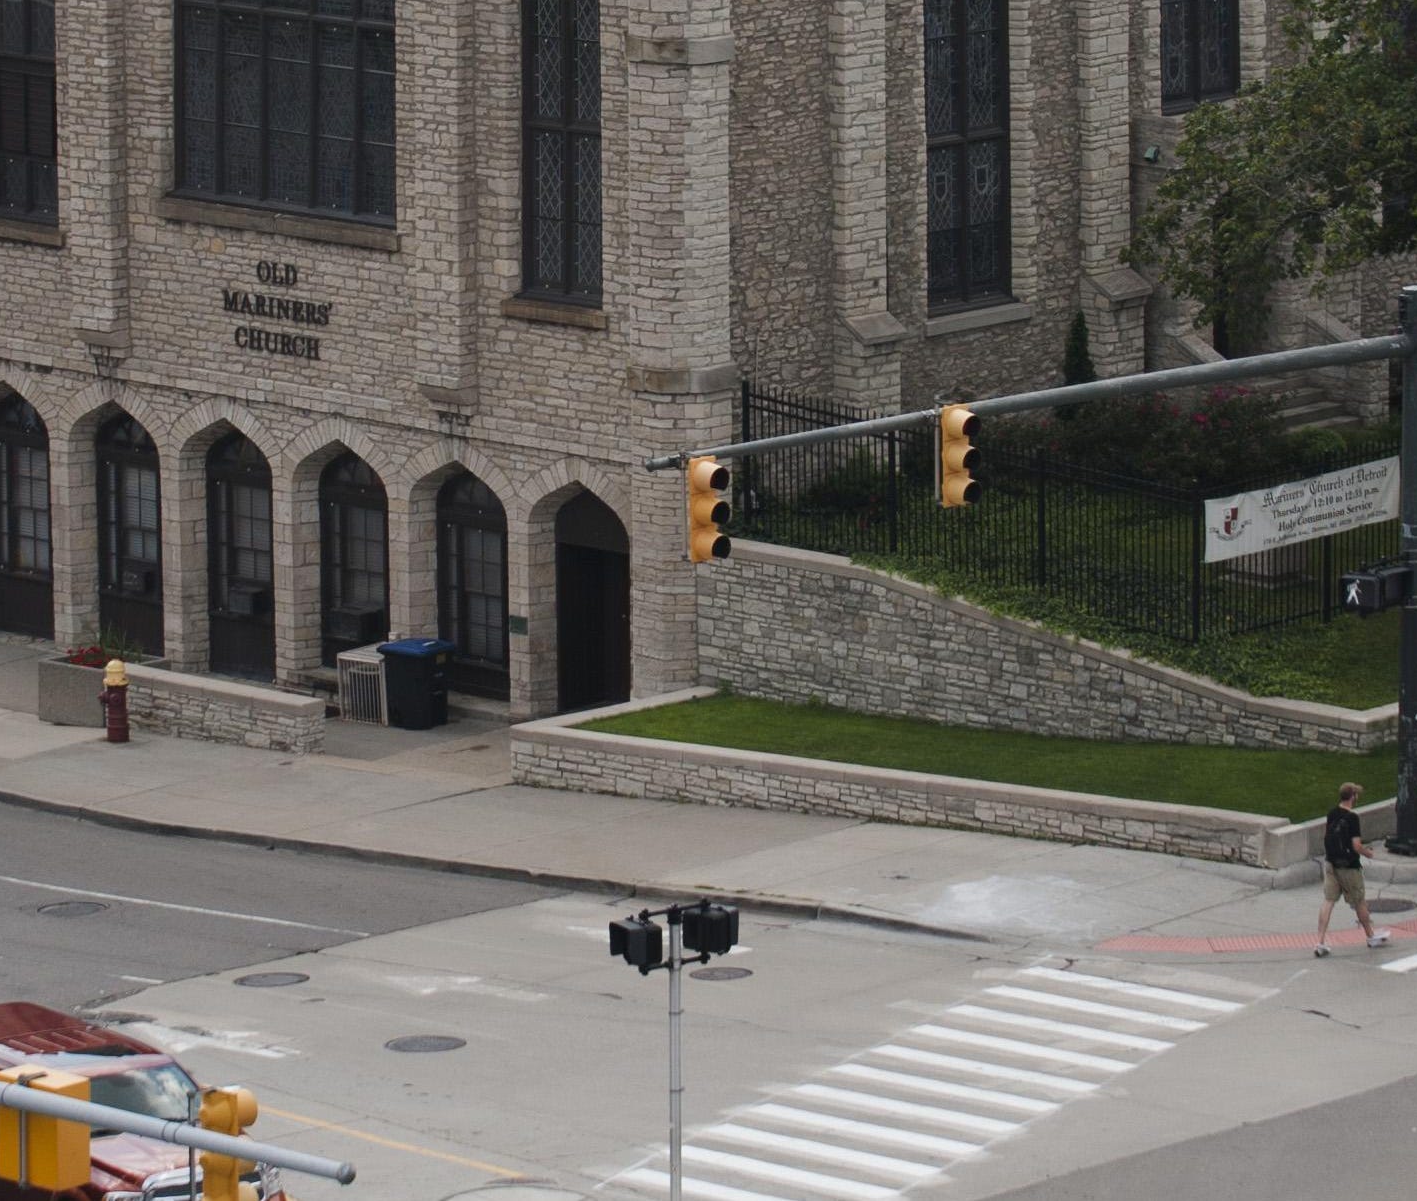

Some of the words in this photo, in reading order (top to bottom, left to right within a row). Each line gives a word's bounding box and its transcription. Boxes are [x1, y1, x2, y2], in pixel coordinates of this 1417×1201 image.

[256, 260, 297, 286] OLD
[222, 289, 333, 325] MARINERS'
[235, 327, 321, 360] CHURCH
[1309, 478, 1344, 496] Church
[1346, 473, 1354, 487] of
[1356, 465, 1388, 484] Detroit
[1278, 518, 1297, 534] Holy
[1297, 509, 1345, 526] Communion
[1346, 501, 1373, 516] Service
